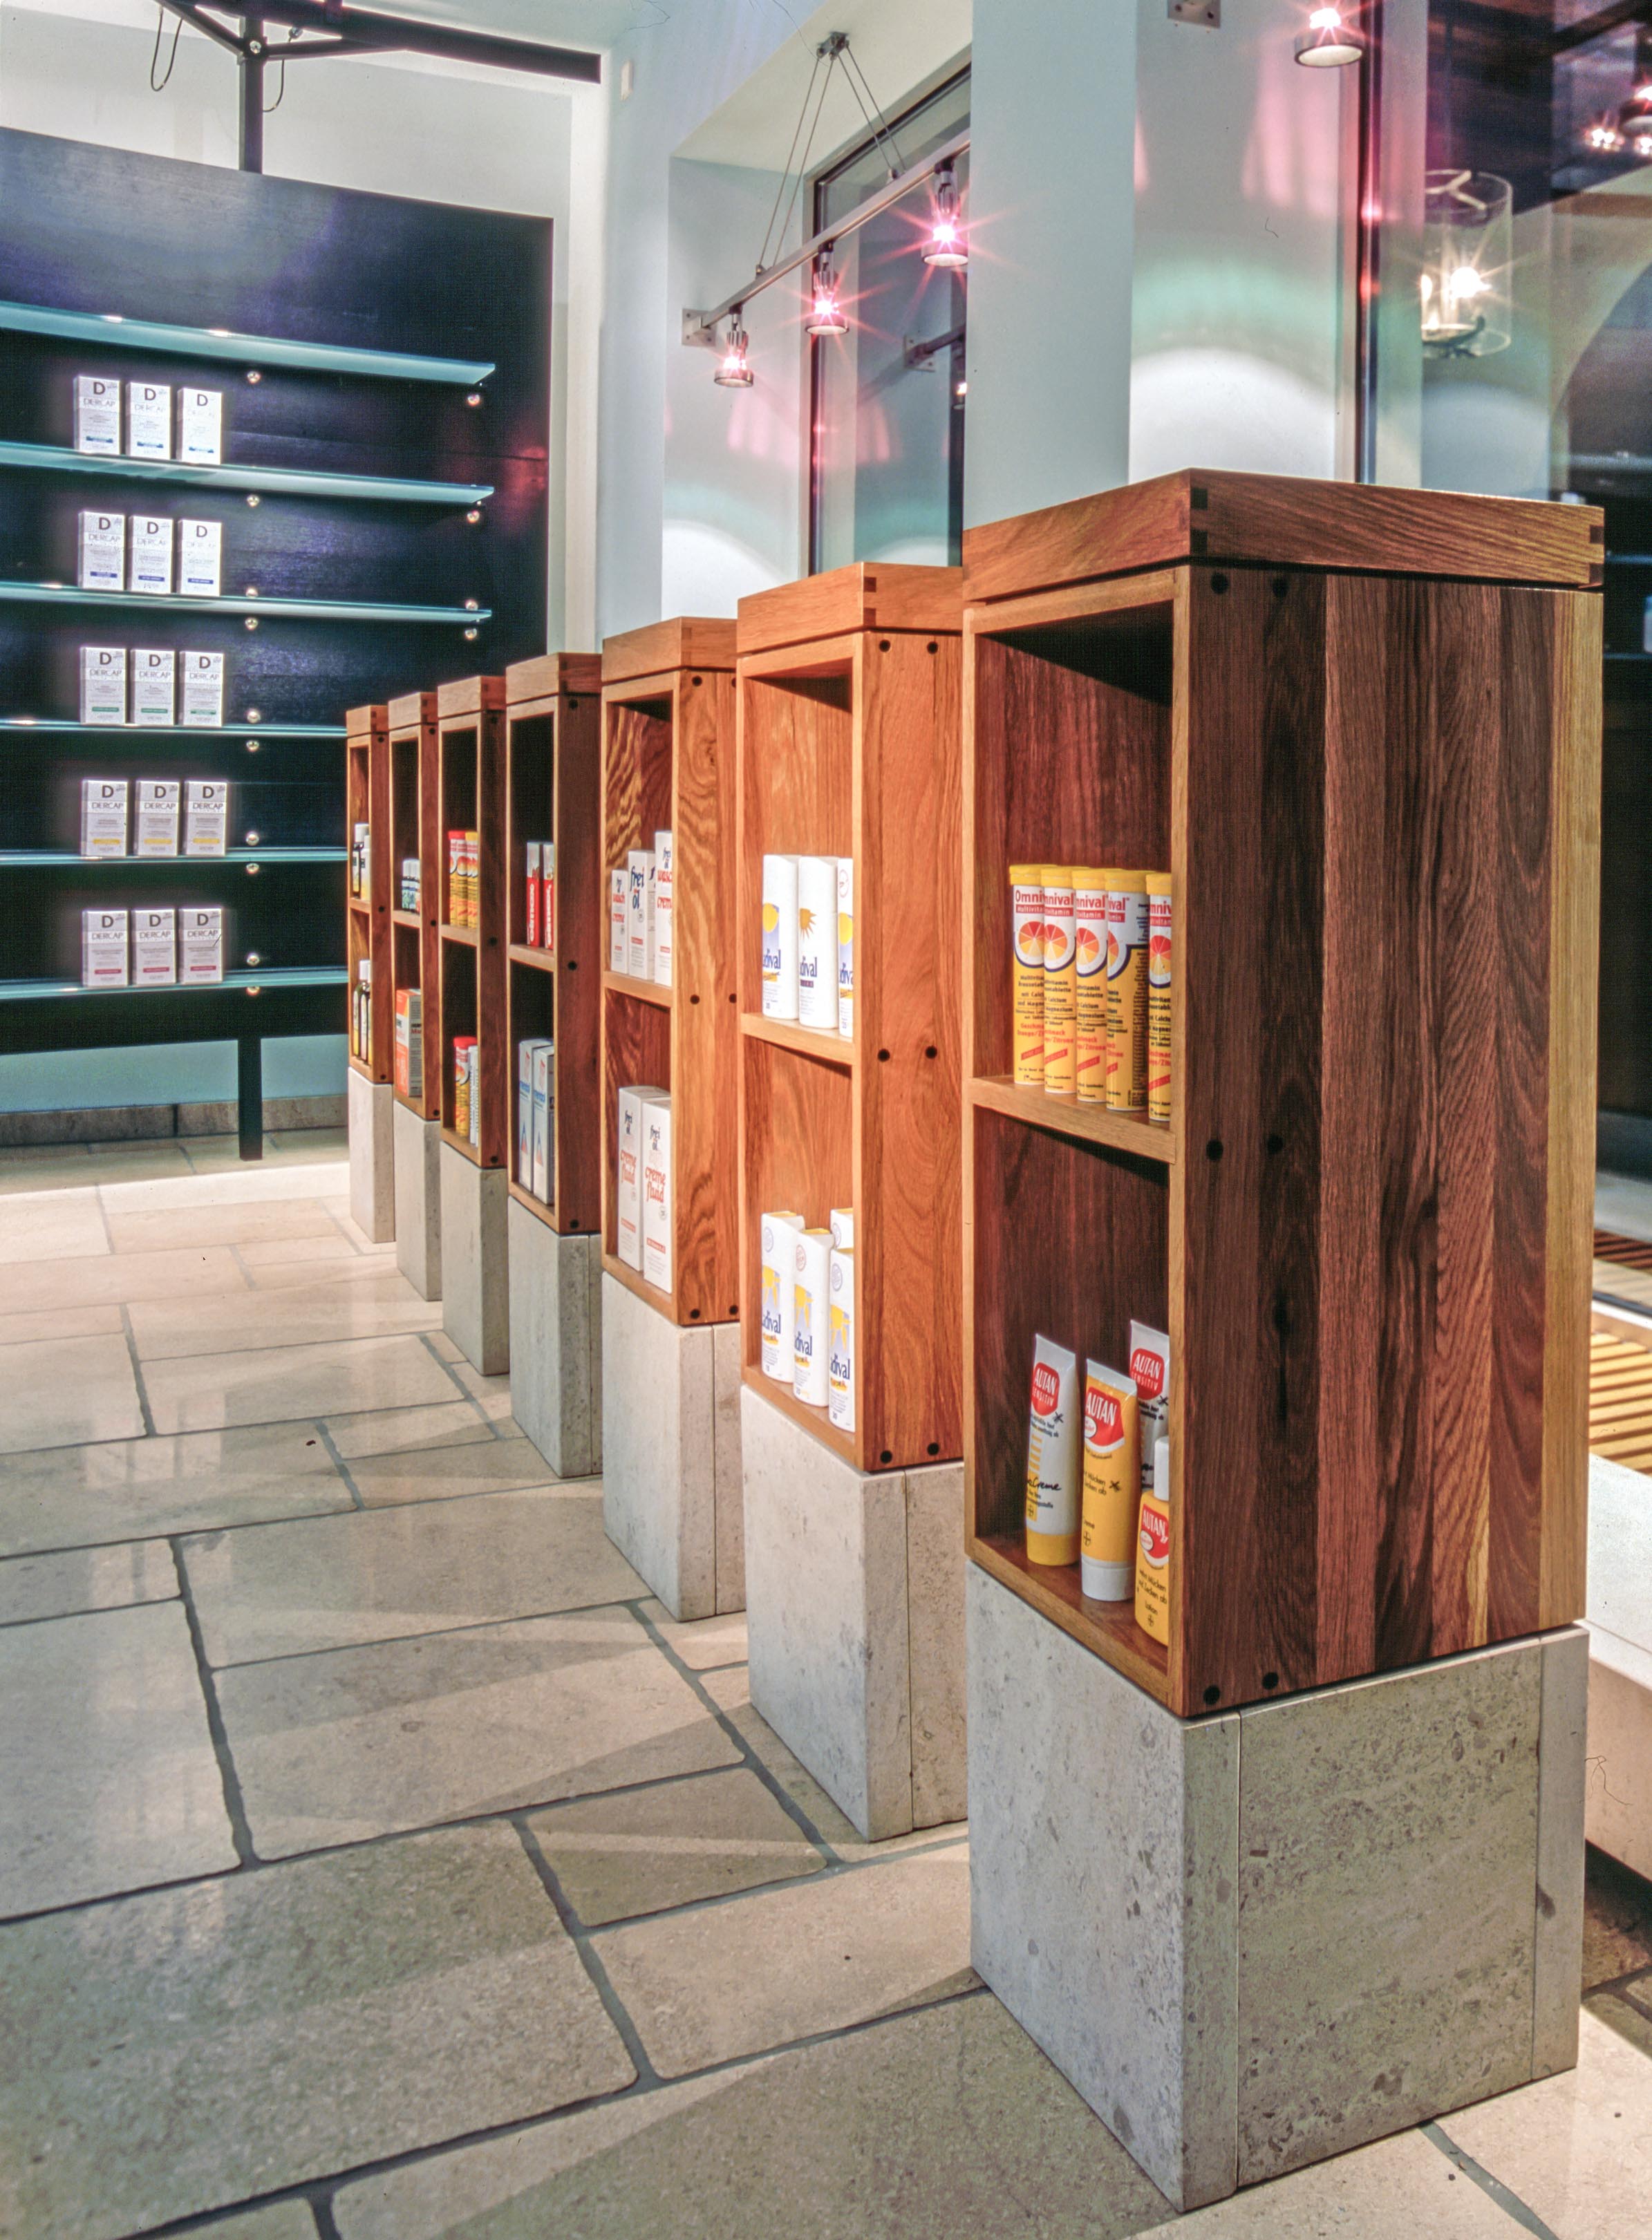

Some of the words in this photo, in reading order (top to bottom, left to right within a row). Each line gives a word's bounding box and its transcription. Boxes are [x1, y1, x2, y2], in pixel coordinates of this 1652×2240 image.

[93, 382, 105, 395] D
[144, 388, 156, 401] D
[197, 394, 208, 406] D
[99, 517, 111, 530] D
[147, 521, 159, 534] D
[196, 525, 207, 538] D
[88, 534, 121, 543] DERCAP
[100, 652, 111, 665] D
[149, 654, 161, 667] D
[199, 656, 211, 669] D
[89, 668, 122, 677] DERCAP
[102, 785, 114, 798] D
[154, 785, 167, 798] D
[203, 786, 214, 798] D
[630, 865, 644, 892] frei
[632, 889, 640, 910] öl
[1015, 890, 1044, 903] Omni
[102, 915, 114, 928] D
[149, 914, 161, 927] D
[197, 913, 208, 926] D
[91, 932, 123, 940] DERCAP
[139, 930, 171, 939] DERCAP
[624, 1109, 632, 1124] frei
[650, 1124, 660, 1140] frei
[645, 1166, 666, 1186] creme
[646, 1180, 664, 1203] fluid
[1134, 1353, 1161, 1380] AUTAN
[1035, 1368, 1057, 1395] AUTAN
[1131, 1371, 1158, 1391] SENSITIV
[1032, 1386, 1054, 1406] SENSITIV
[1085, 1391, 1117, 1427] AUTAN
[1143, 1509, 1166, 1537] AUTAN
[1148, 1574, 1166, 1592] Mücken
